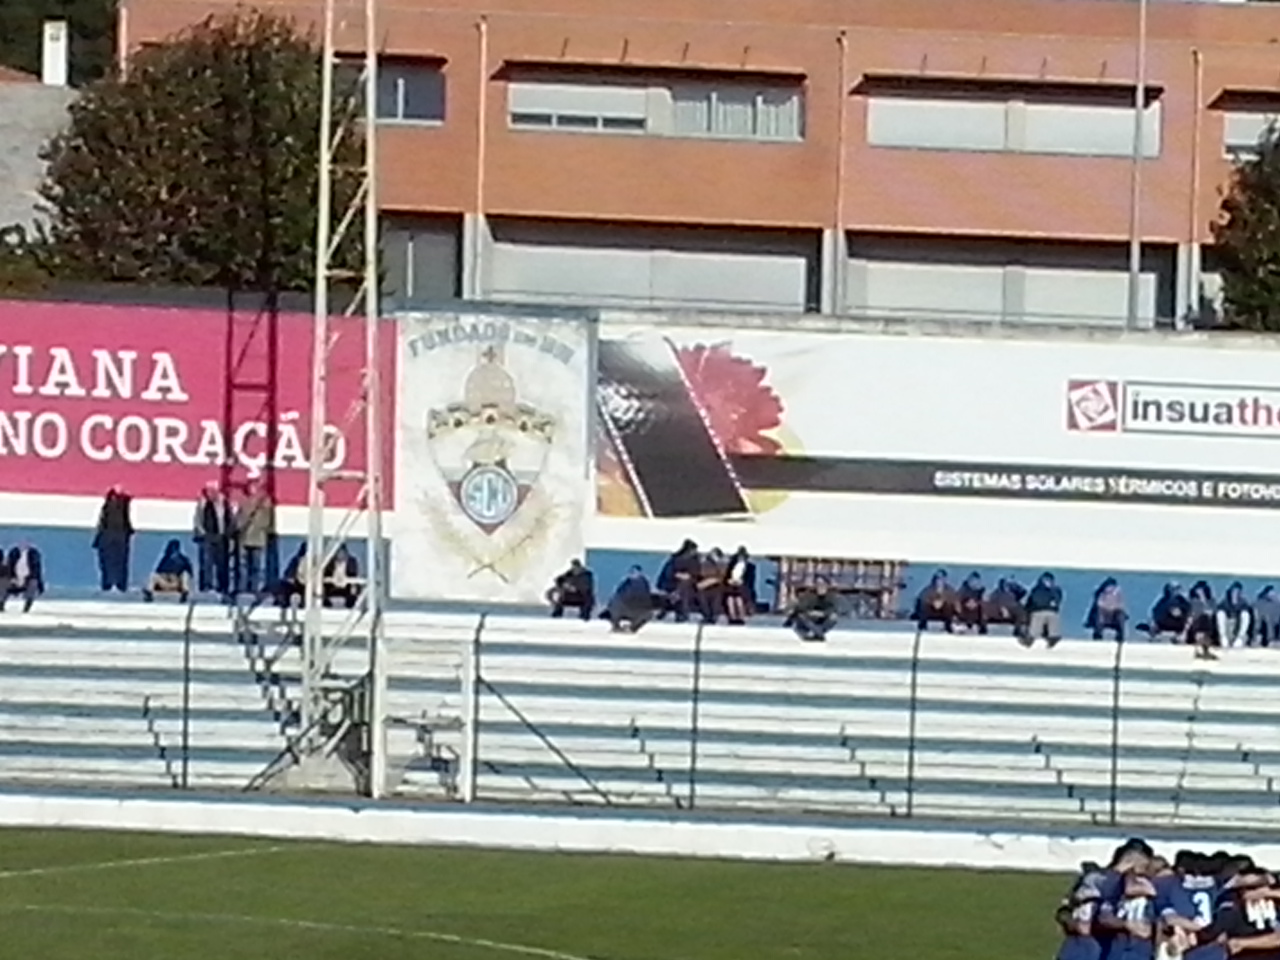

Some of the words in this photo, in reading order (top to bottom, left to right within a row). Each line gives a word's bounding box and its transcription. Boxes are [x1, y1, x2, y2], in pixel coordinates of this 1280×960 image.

[0, 345, 189, 401] IANA
[0, 411, 68, 459] NO
[80, 411, 347, 479] CORAÇÃO
[934, 470, 1021, 489] SISTEMAS
[1024, 474, 1105, 493] SOLARES
[1201, 481, 1214, 498] E
[1193, 891, 1213, 928] 3
